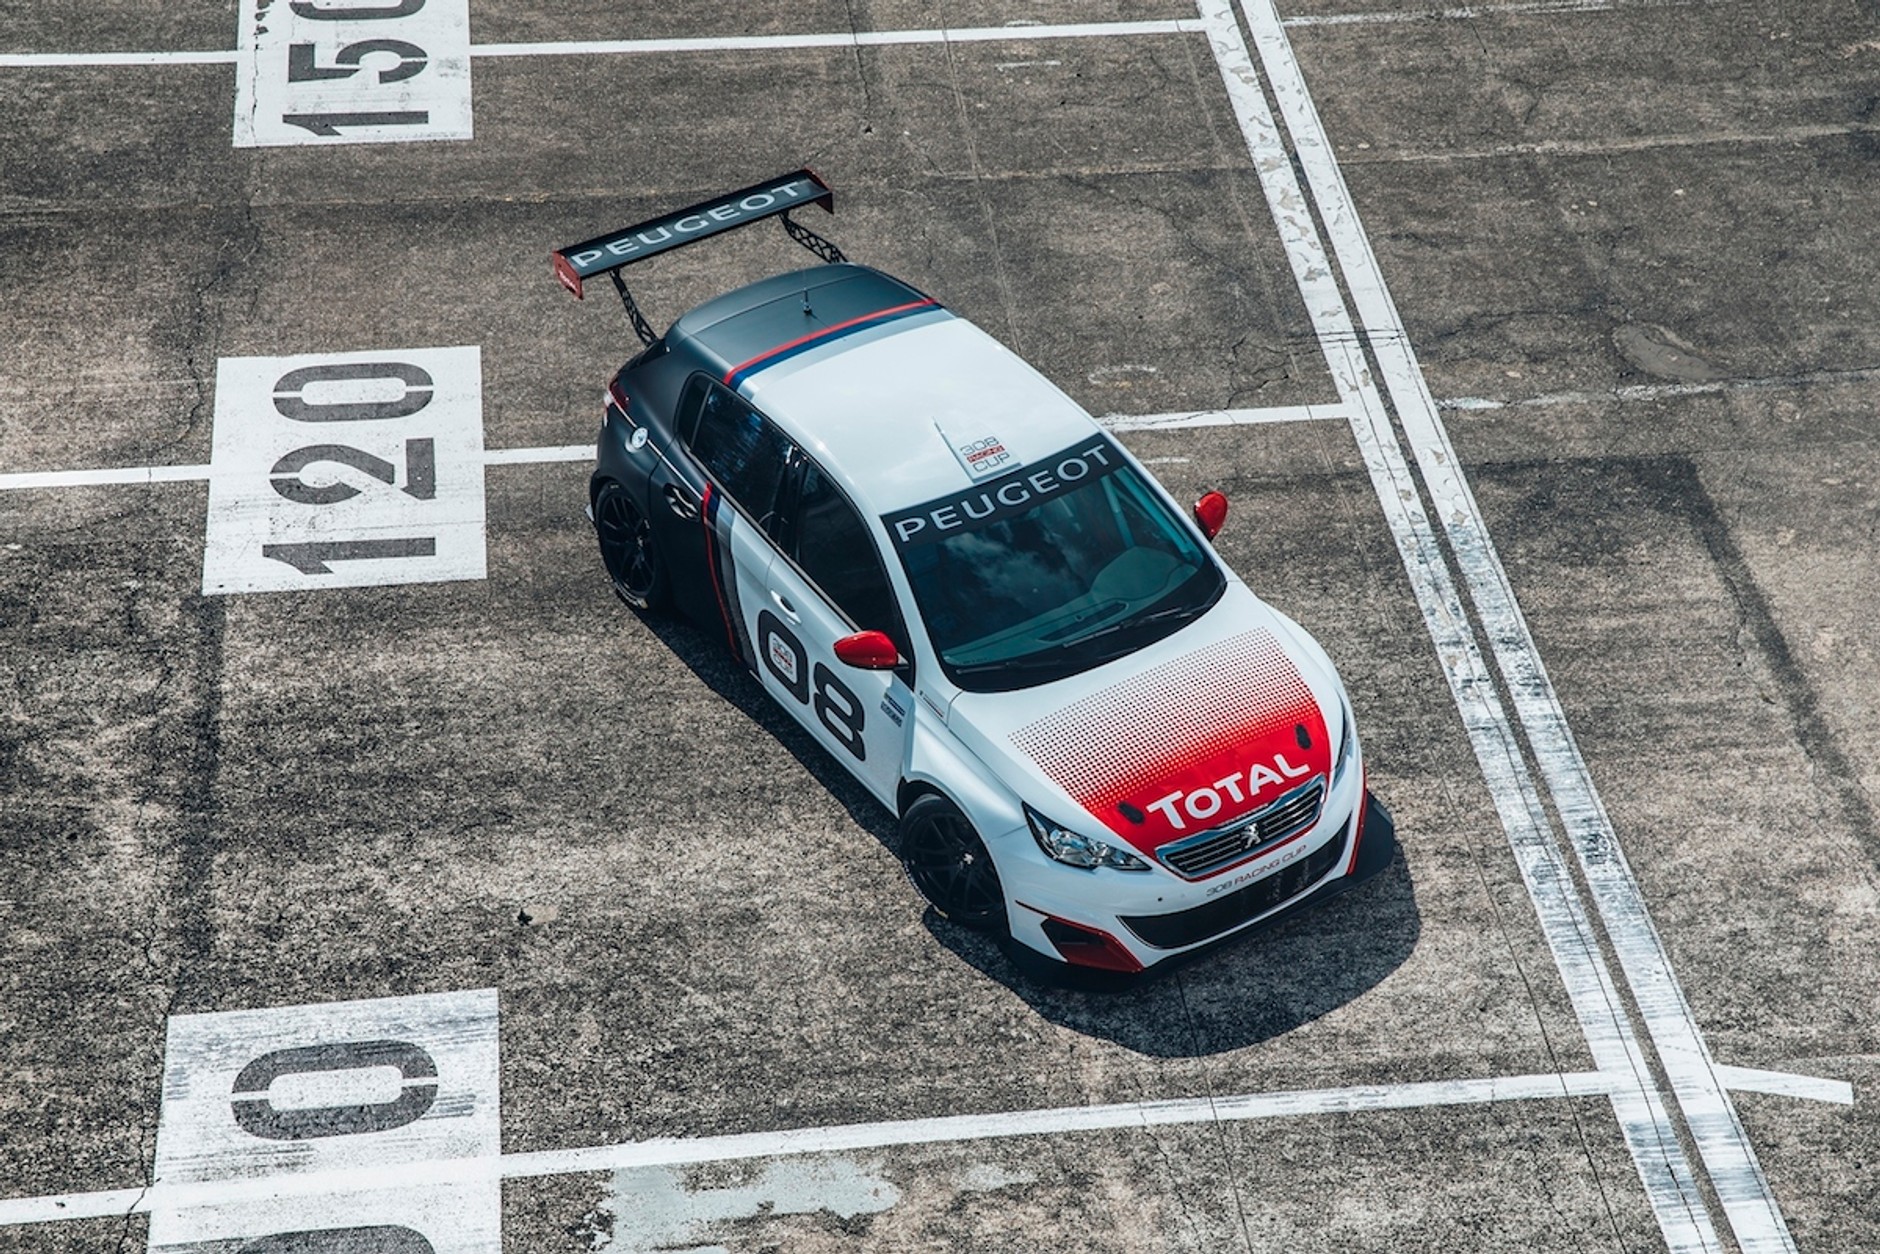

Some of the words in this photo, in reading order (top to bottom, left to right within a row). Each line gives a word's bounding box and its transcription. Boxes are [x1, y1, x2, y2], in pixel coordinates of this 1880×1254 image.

[571, 181, 799, 268] PEUGEOT
[262, 362, 437, 575] 120
[960, 436, 999, 456] 308
[972, 451, 1010, 472] CUP
[894, 443, 1110, 543] PEUGEOT
[758, 609, 867, 762] 08
[1146, 753, 1311, 830] TOTAL
[1206, 880, 1233, 897] 308
[1234, 858, 1280, 885] RACING
[1282, 844, 1307, 863] CUP
